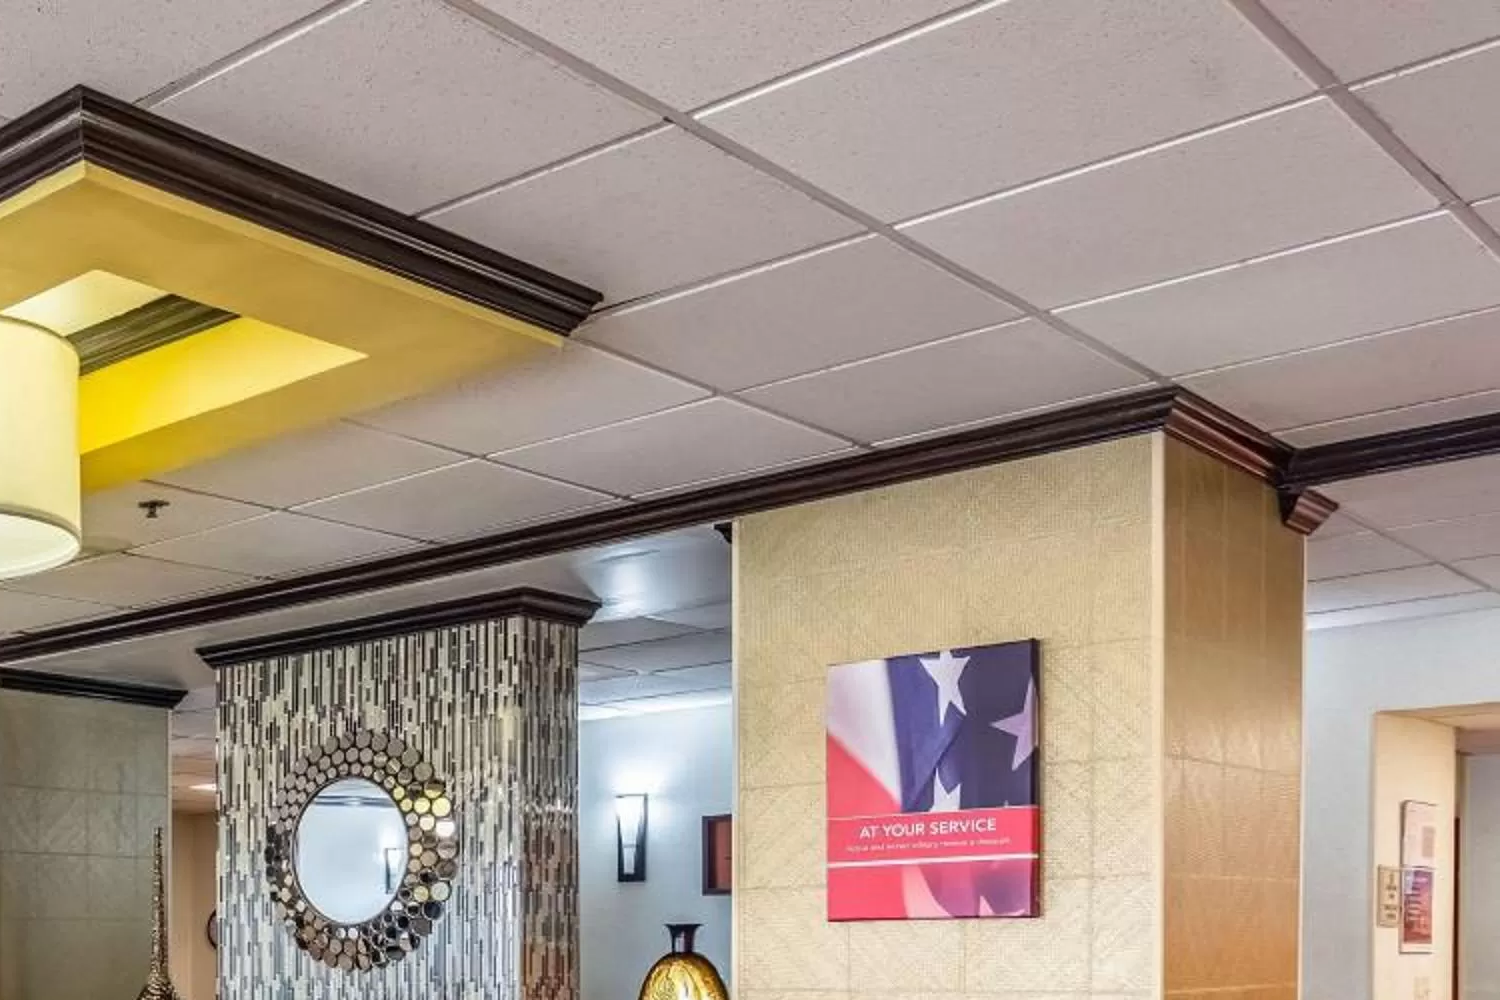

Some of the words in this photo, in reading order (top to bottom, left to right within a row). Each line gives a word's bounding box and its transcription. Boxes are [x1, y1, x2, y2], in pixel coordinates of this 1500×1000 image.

[859, 825, 879, 839] AT
[882, 823, 925, 838] YOUR
[929, 818, 997, 835] SERVICE
